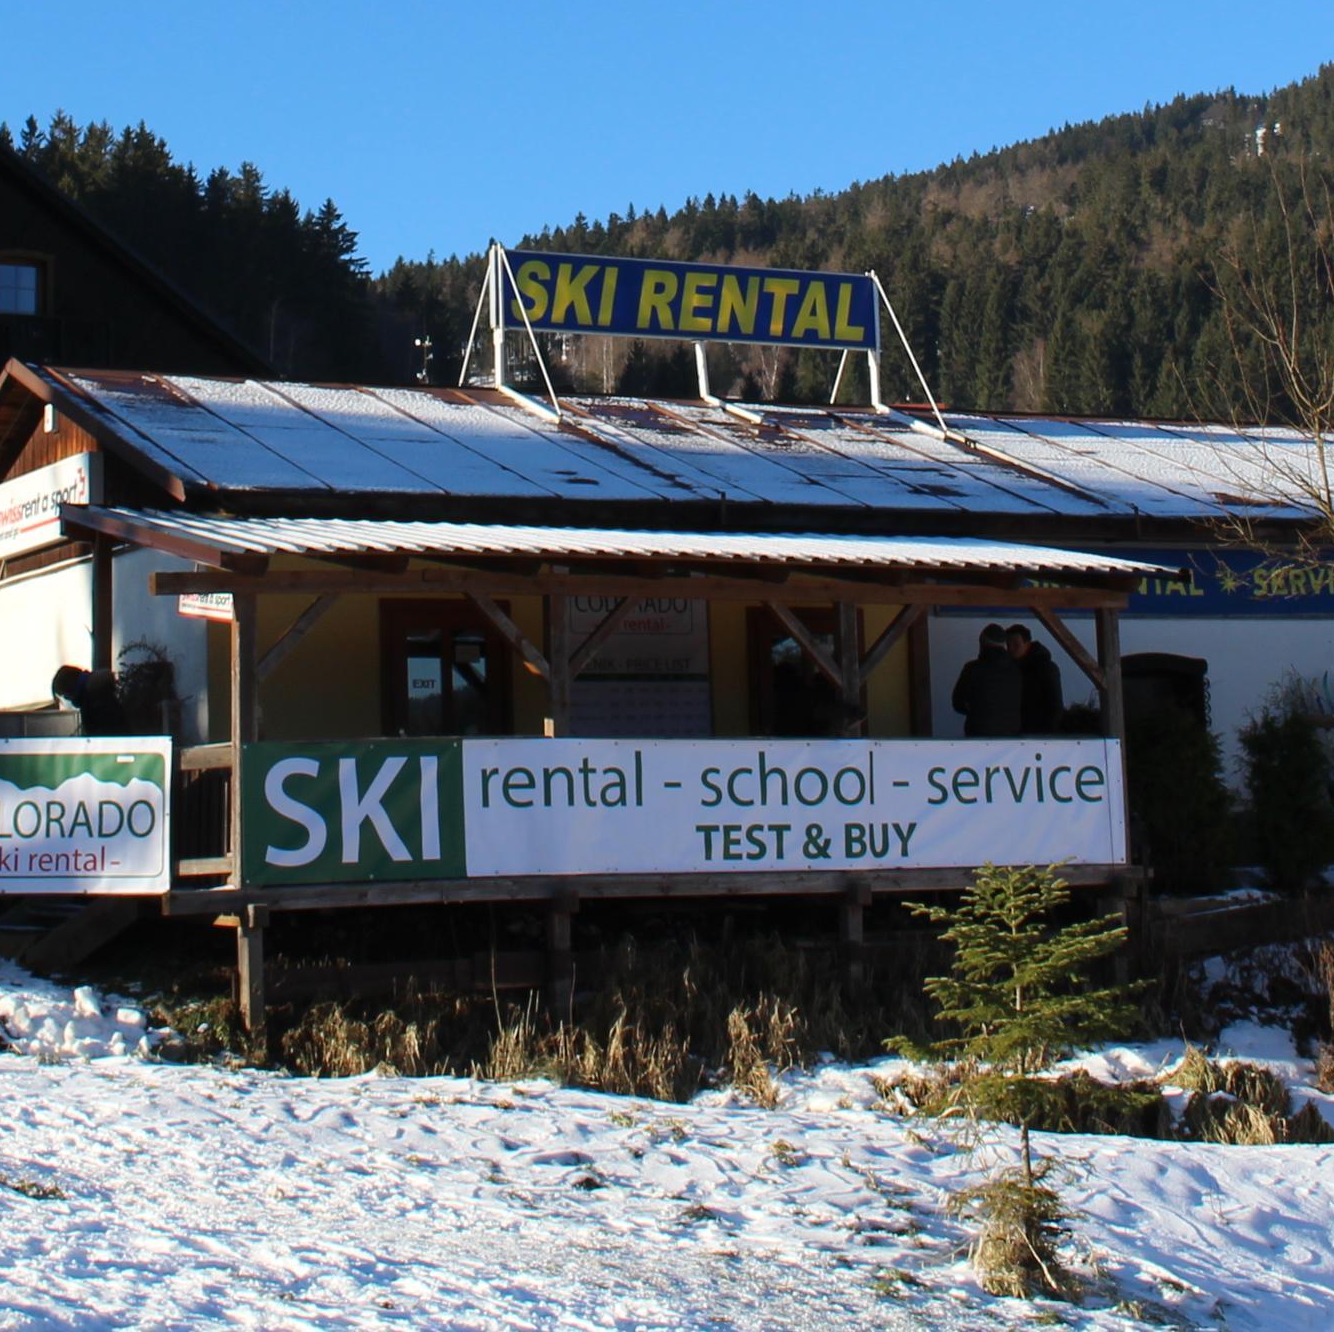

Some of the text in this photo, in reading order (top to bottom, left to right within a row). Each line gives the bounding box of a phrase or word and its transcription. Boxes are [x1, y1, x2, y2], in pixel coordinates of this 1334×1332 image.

[511, 260, 865, 342] SKI RENTAL
[575, 596, 688, 613] COLADO
[412, 679, 436, 689] EXIT
[264, 755, 442, 867] SKI
[480, 750, 643, 809] rental
[700, 750, 875, 807] school
[927, 753, 1105, 805] service
[695, 822, 918, 861] TEST & BUY
